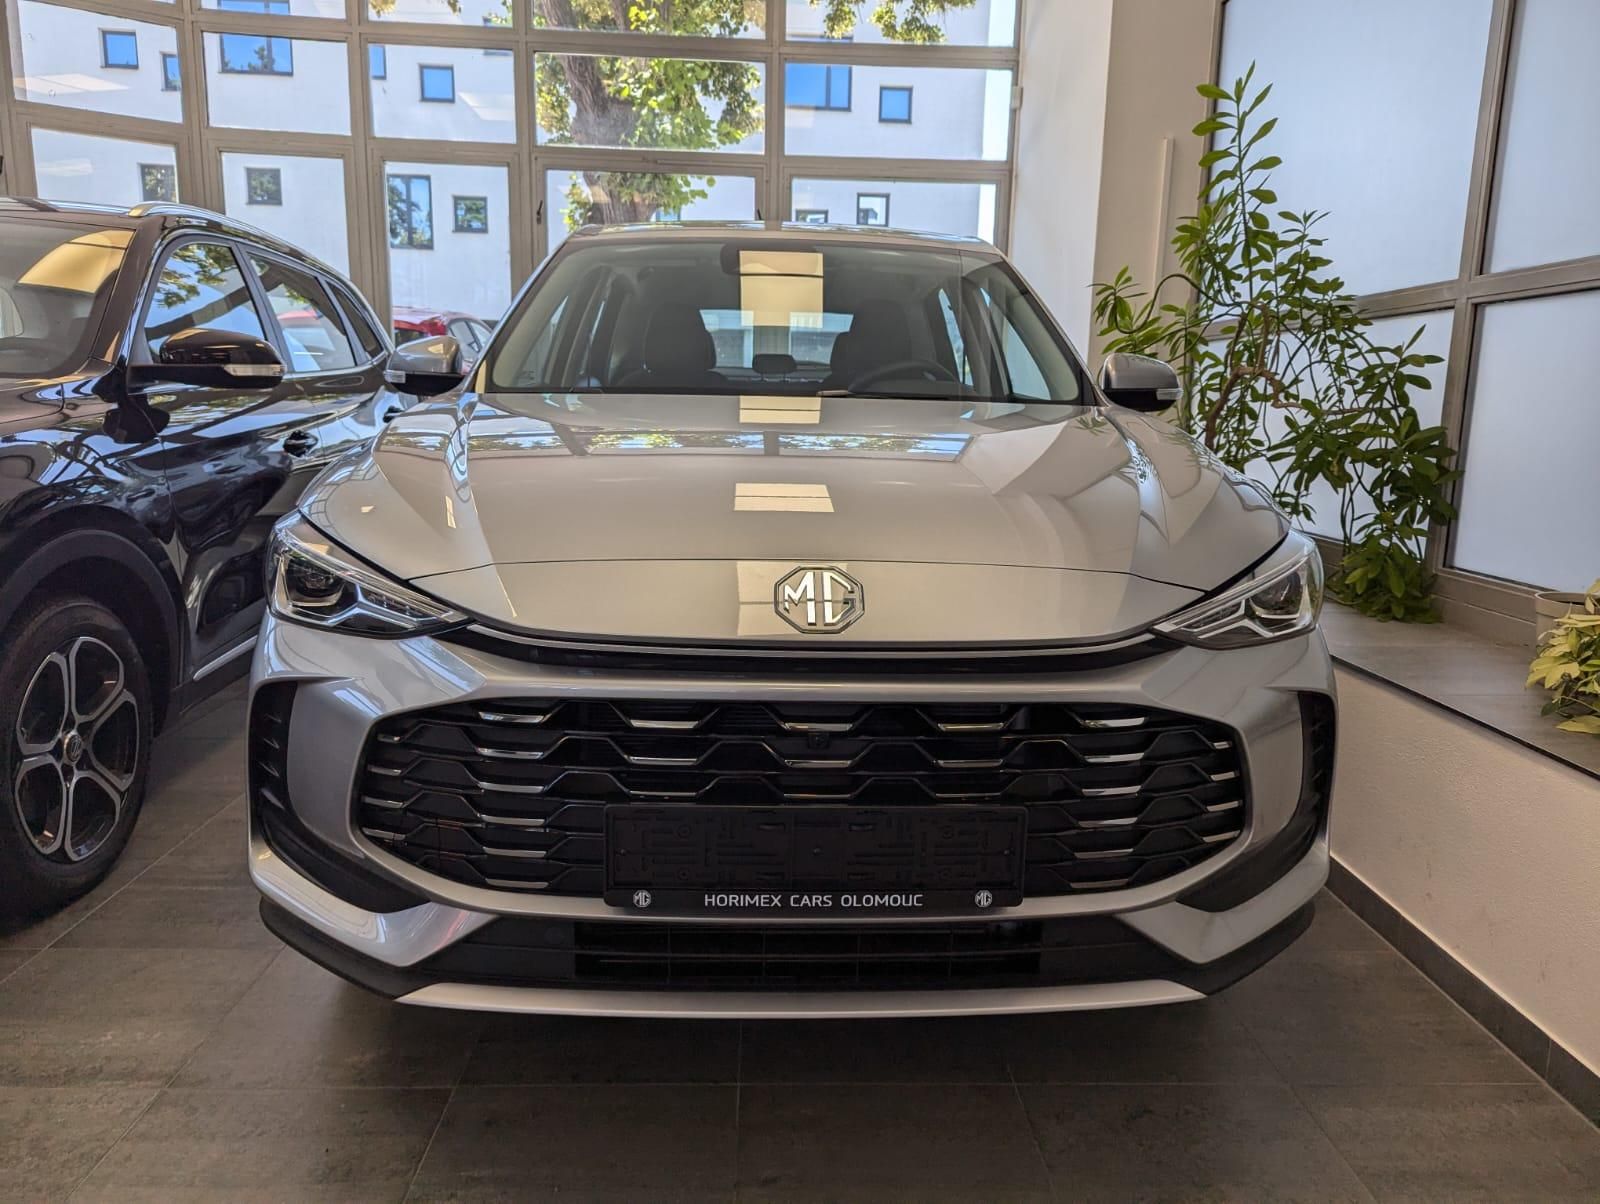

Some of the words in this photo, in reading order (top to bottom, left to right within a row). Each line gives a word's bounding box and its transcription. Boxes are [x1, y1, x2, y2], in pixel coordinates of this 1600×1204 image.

[783, 570, 857, 626] MG
[633, 889, 651, 907] MG
[704, 893, 782, 907] HORIMEX
[789, 894, 833, 907] CARS
[840, 894, 924, 907] OLOMOUC
[974, 889, 993, 908] MG
